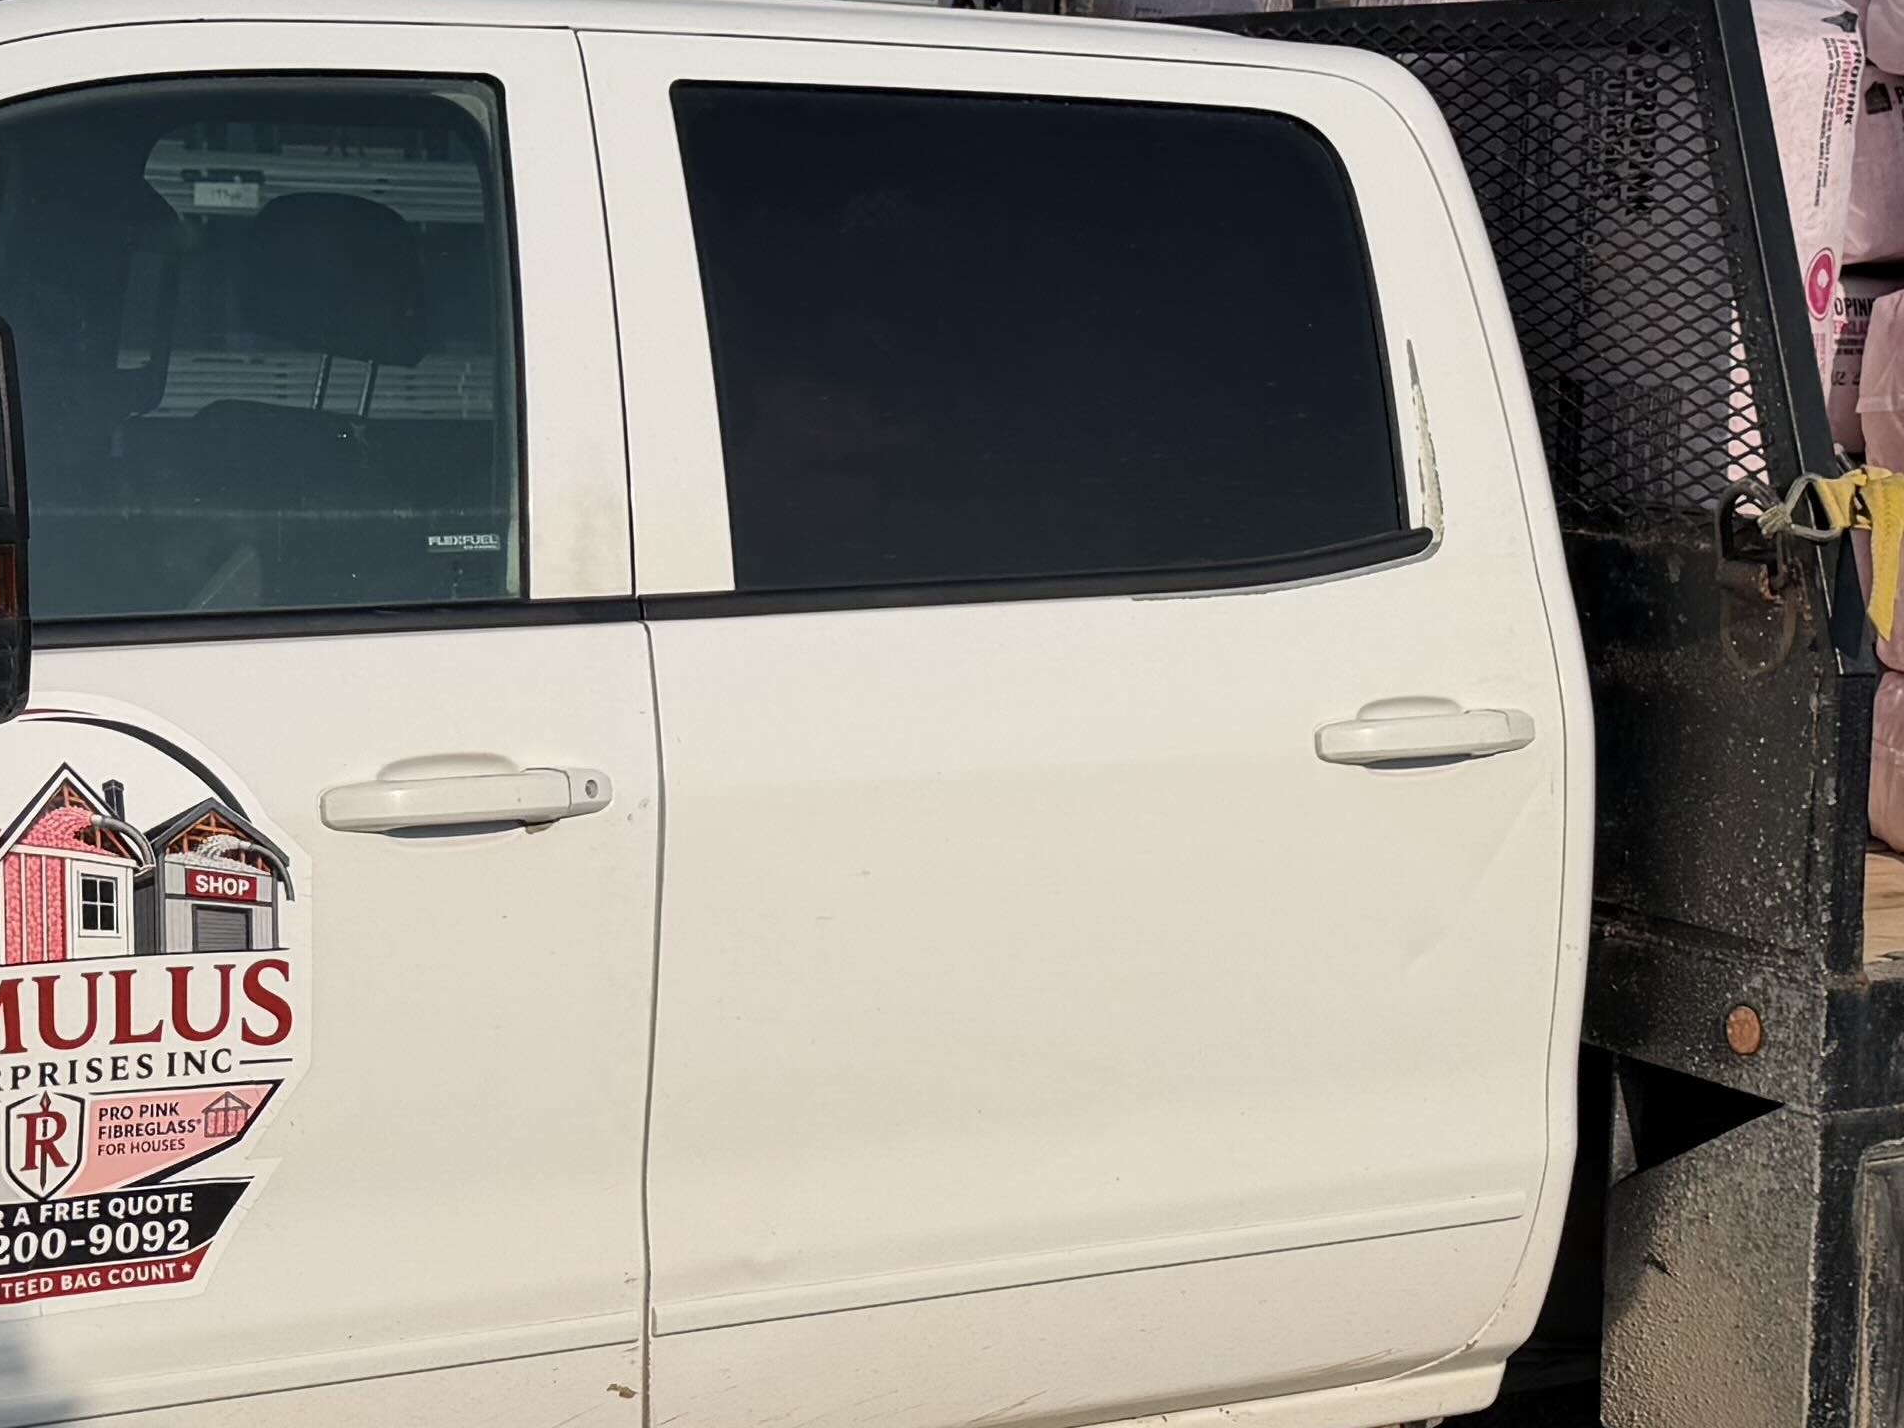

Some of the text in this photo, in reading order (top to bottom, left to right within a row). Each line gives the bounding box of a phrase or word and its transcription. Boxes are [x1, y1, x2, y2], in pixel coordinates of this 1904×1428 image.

[1844, 40, 1862, 126] PROPINK
[194, 874, 251, 897] SHOP
[167, 1048, 233, 1077] INC
[99, 1102, 180, 1122] PRO PINK
[98, 1118, 197, 1139] FIBREGLASS
[97, 1138, 186, 1156] FOR HOUSES
[13, 1206, 31, 1227] A
[40, 1199, 101, 1223] FREE
[108, 1192, 194, 1217] QUOTE
[61, 1272, 102, 1291] BAG
[108, 1262, 177, 1284] COUNT
